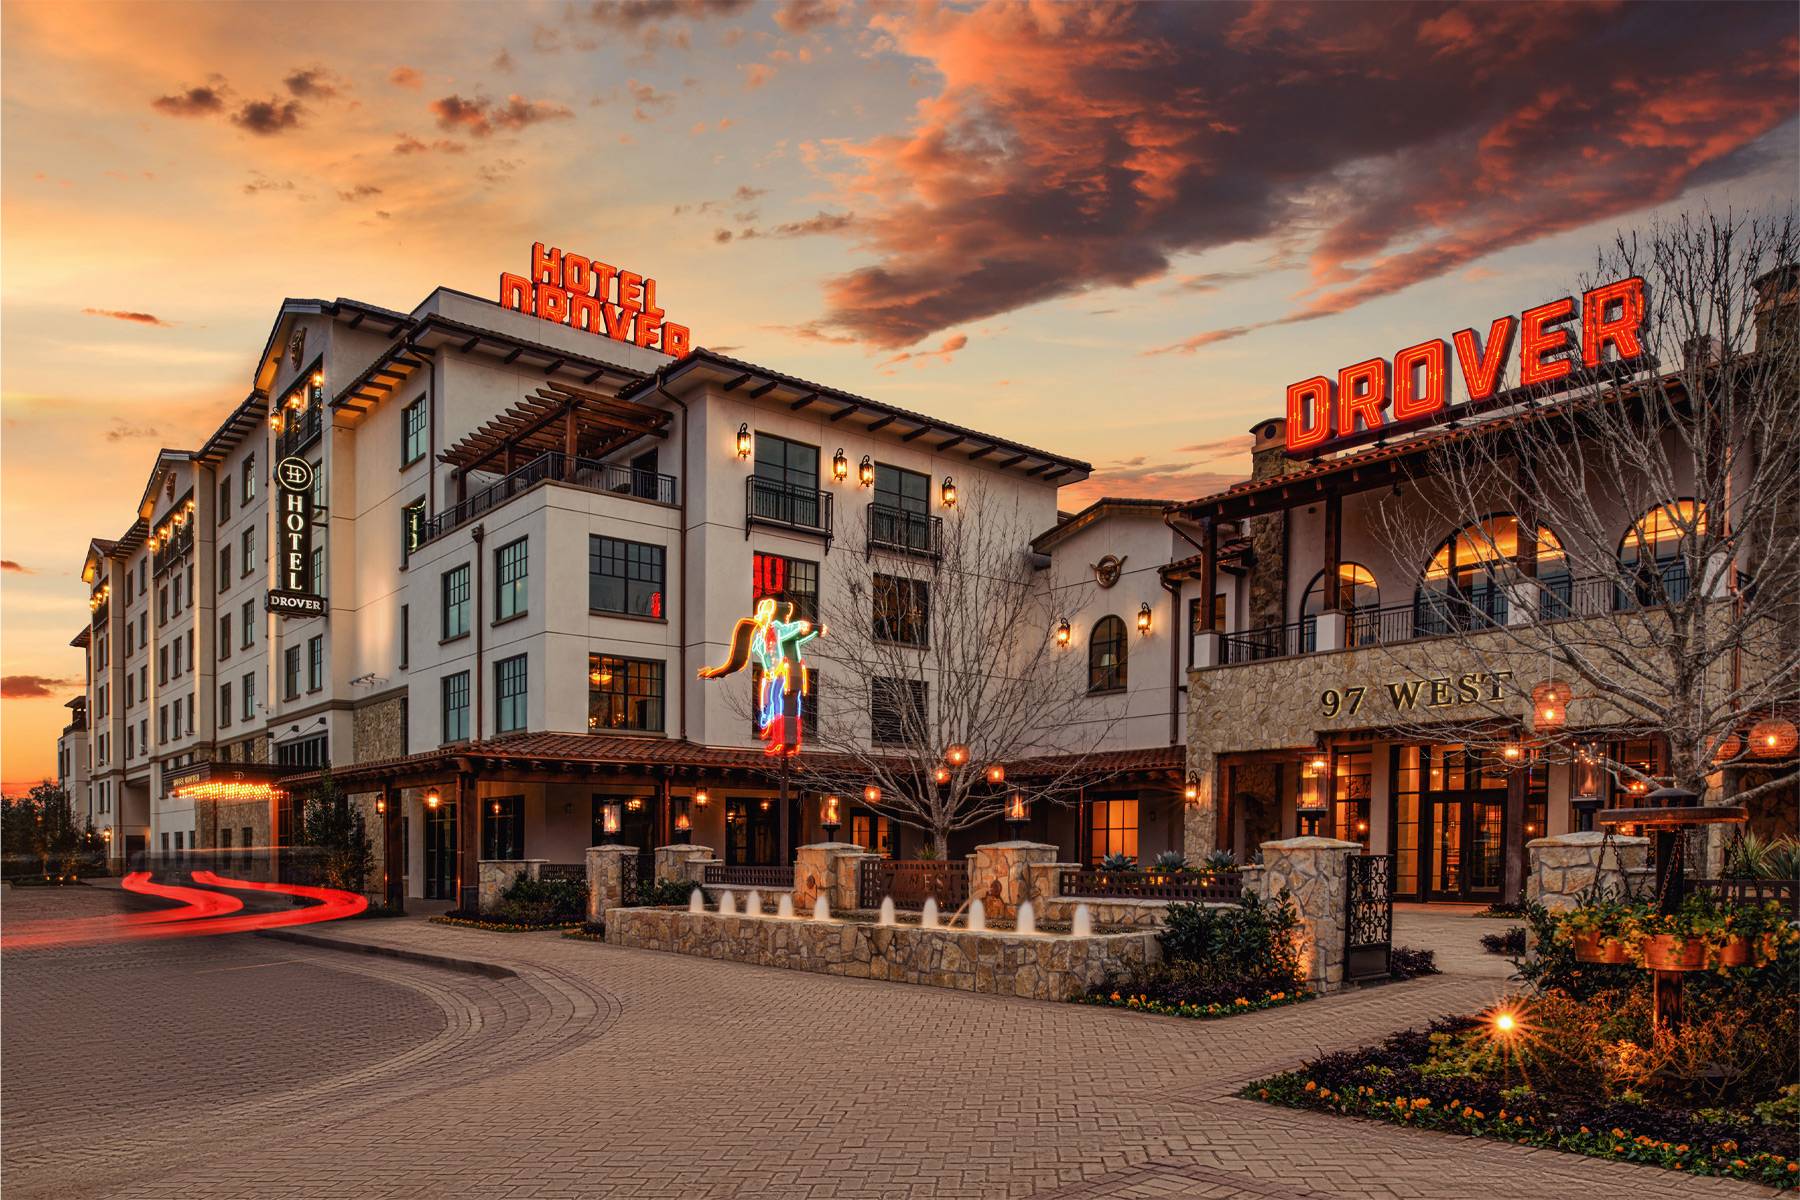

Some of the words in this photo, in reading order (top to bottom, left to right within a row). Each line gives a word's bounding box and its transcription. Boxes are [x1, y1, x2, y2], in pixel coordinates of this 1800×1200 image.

[500, 271, 690, 361] DROVER
[532, 241, 665, 319] HOTEL
[1286, 275, 1650, 452] DROVER
[287, 493, 304, 591] HOTEL
[270, 595, 322, 611] DROVER
[1321, 686, 1367, 719] 97
[1384, 671, 1513, 711] WEST
